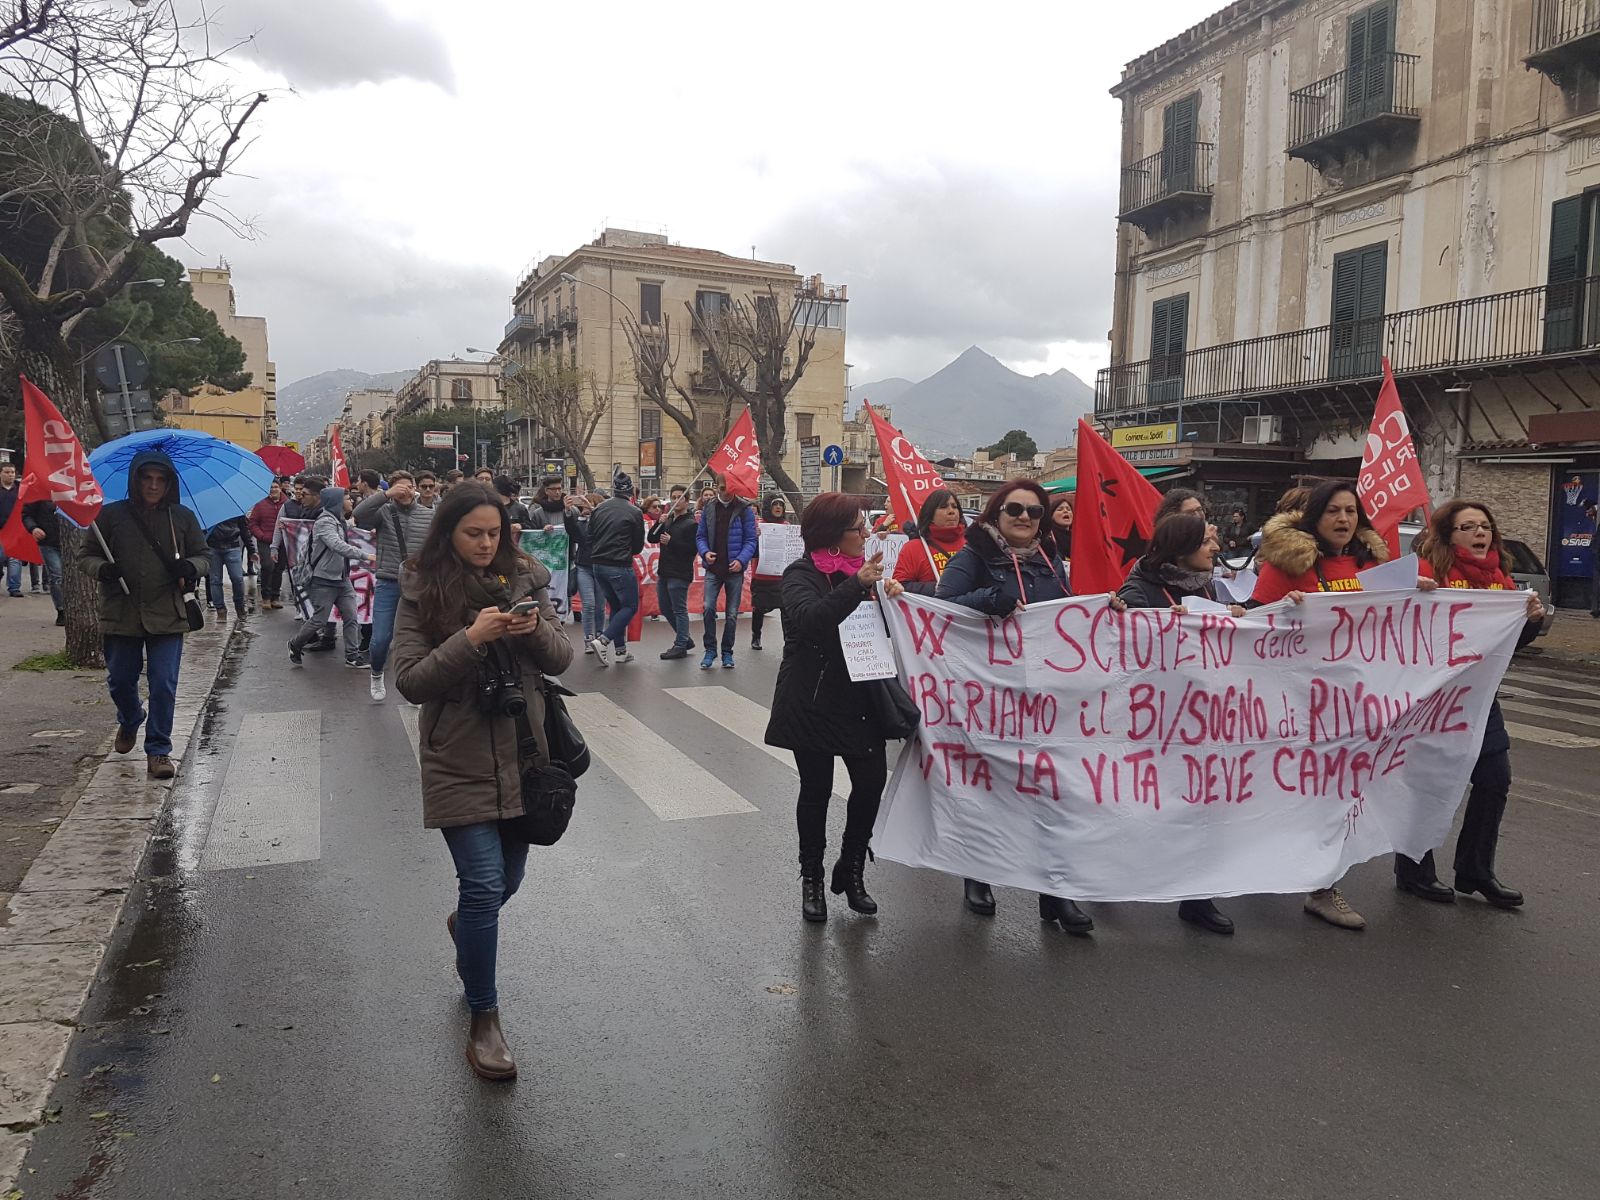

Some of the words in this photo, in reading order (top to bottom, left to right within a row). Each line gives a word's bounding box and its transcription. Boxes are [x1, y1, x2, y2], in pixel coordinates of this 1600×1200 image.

[916, 464, 931, 475] IL
[1149, 449, 1174, 459] SICILIA
[914, 479, 930, 491] DI
[986, 615, 1023, 666] LO
[1044, 604, 1238, 673] SCIOPERO
[1254, 613, 1308, 660] delle
[1322, 597, 1483, 668] DONNE
[910, 672, 1057, 740] IBERIAMO
[1279, 690, 1299, 738] di
[916, 738, 993, 791] UTTA
[1016, 749, 1060, 801] LA
[1082, 750, 1160, 811] VITA
[1182, 750, 1255, 804] DEVE
